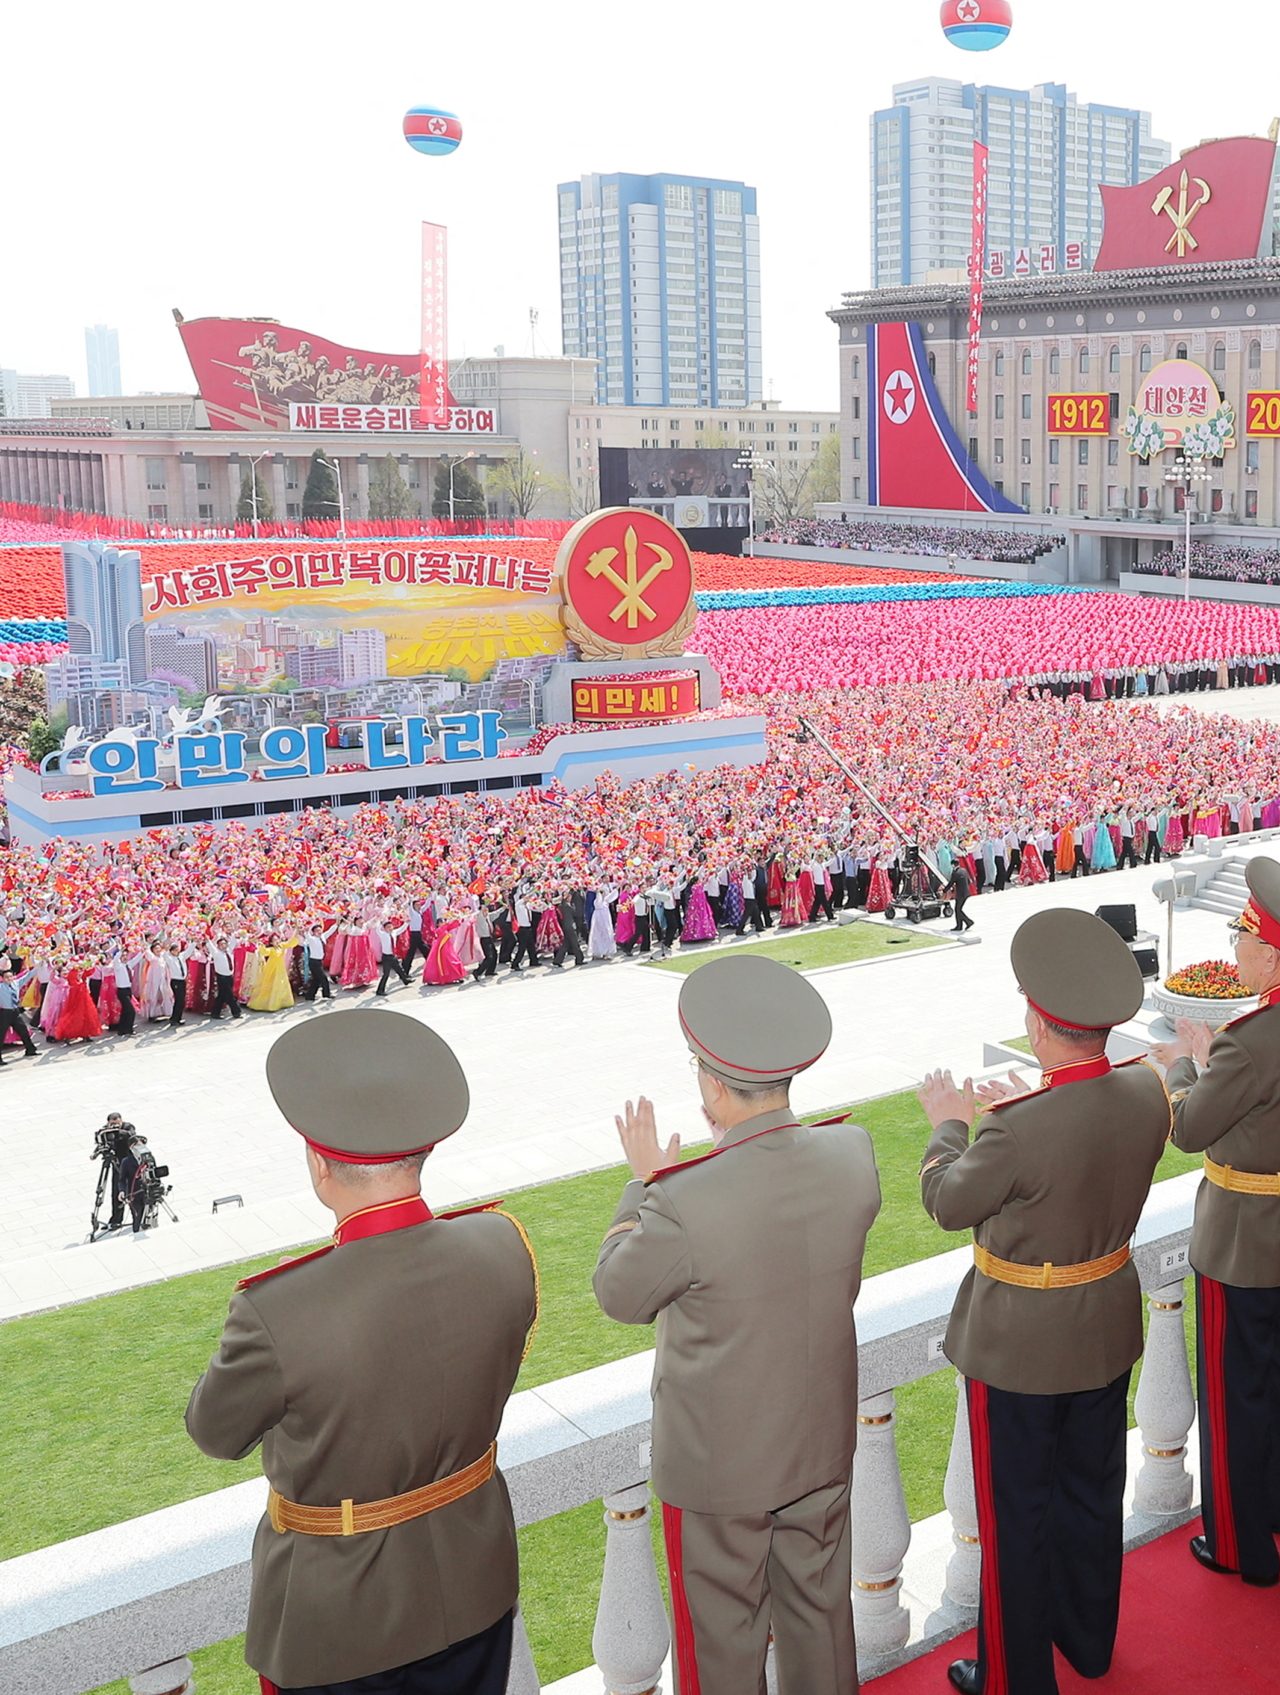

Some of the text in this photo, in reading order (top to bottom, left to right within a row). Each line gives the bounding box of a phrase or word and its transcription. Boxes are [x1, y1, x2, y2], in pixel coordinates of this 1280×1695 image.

[1052, 398, 1105, 429] 1912
[1144, 386, 1208, 415] 태양절
[87, 709, 508, 797] 인민의 나라
